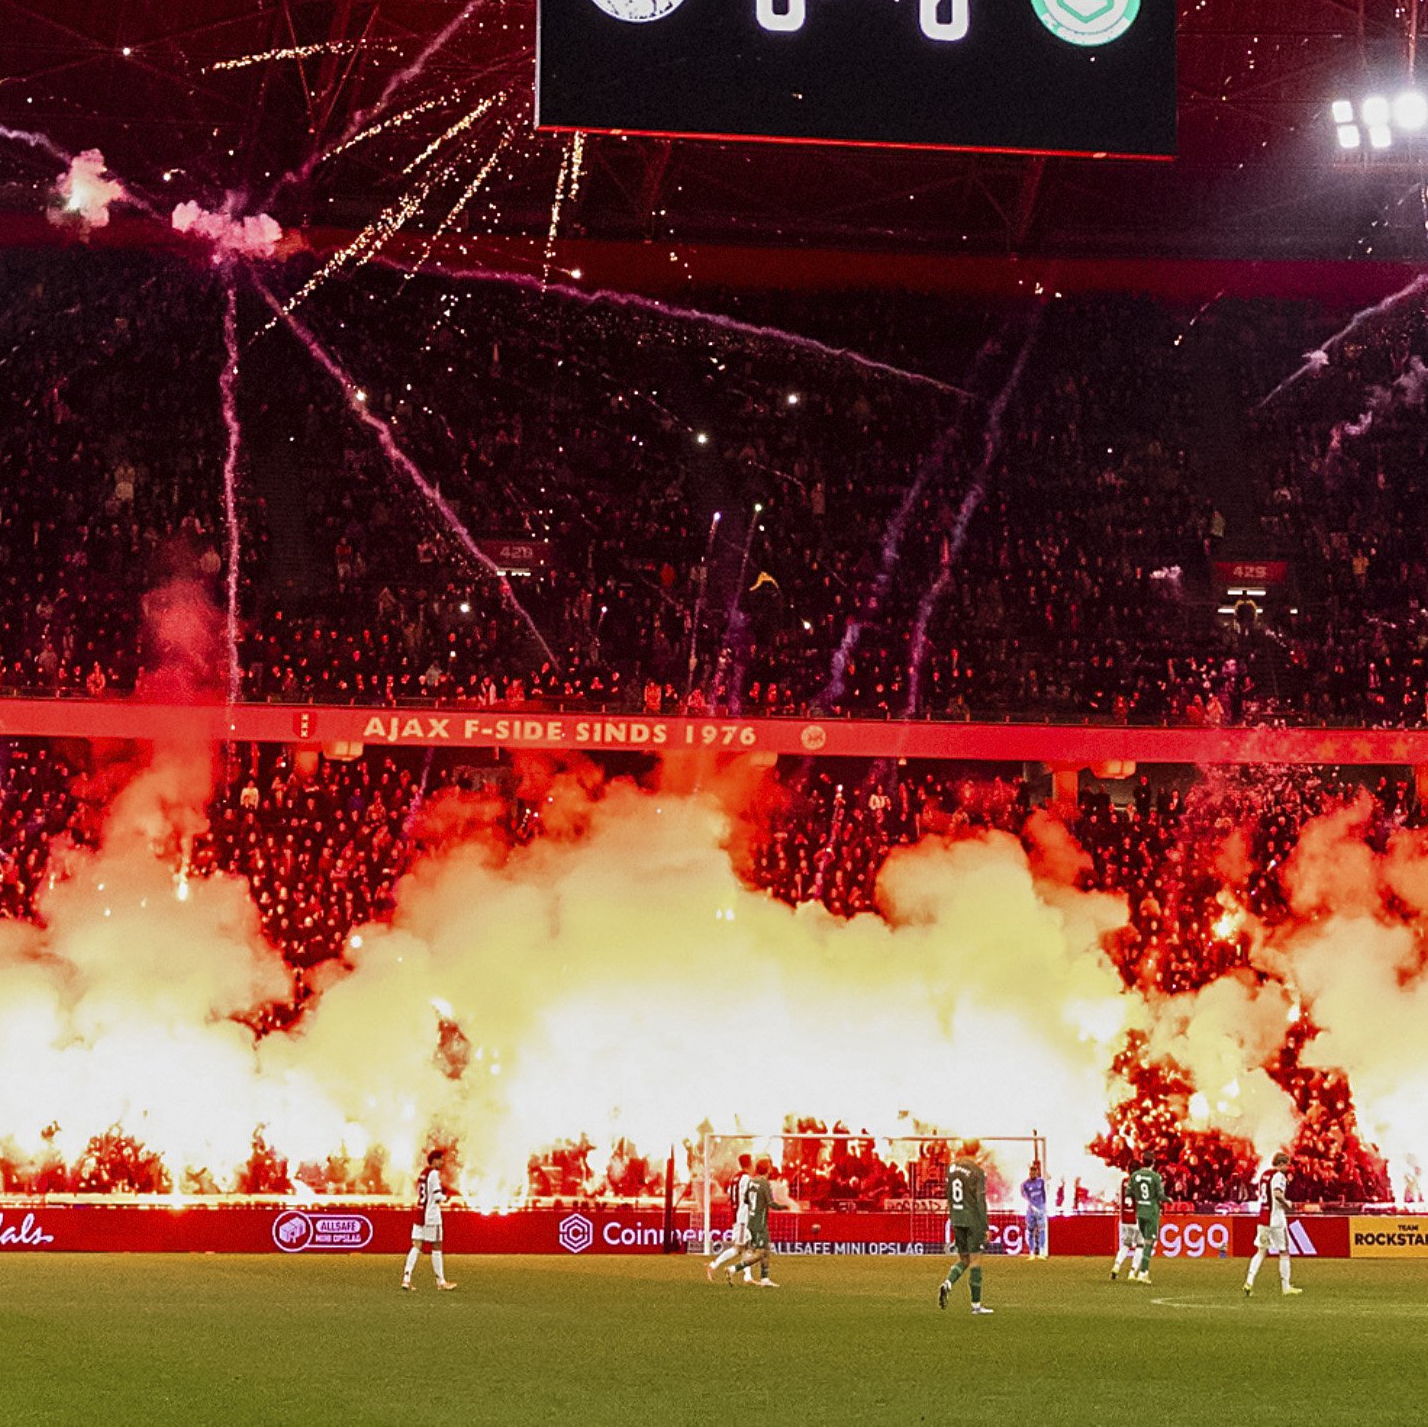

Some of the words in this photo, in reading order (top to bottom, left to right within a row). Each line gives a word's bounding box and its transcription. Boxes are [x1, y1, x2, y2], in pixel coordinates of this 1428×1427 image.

[363, 717, 450, 743] AJAX
[465, 719, 562, 741] F-SIDE
[576, 722, 668, 744] SINDS
[686, 725, 756, 745] 1976
[952, 1177, 964, 1204] 6
[1141, 1182, 1151, 1201] 9
[320, 1219, 357, 1232] ALLSAFE
[1398, 1224, 1419, 1232] TEAM
[834, 1242, 866, 1256] MINI
[869, 1242, 924, 1256] OPSLAG
